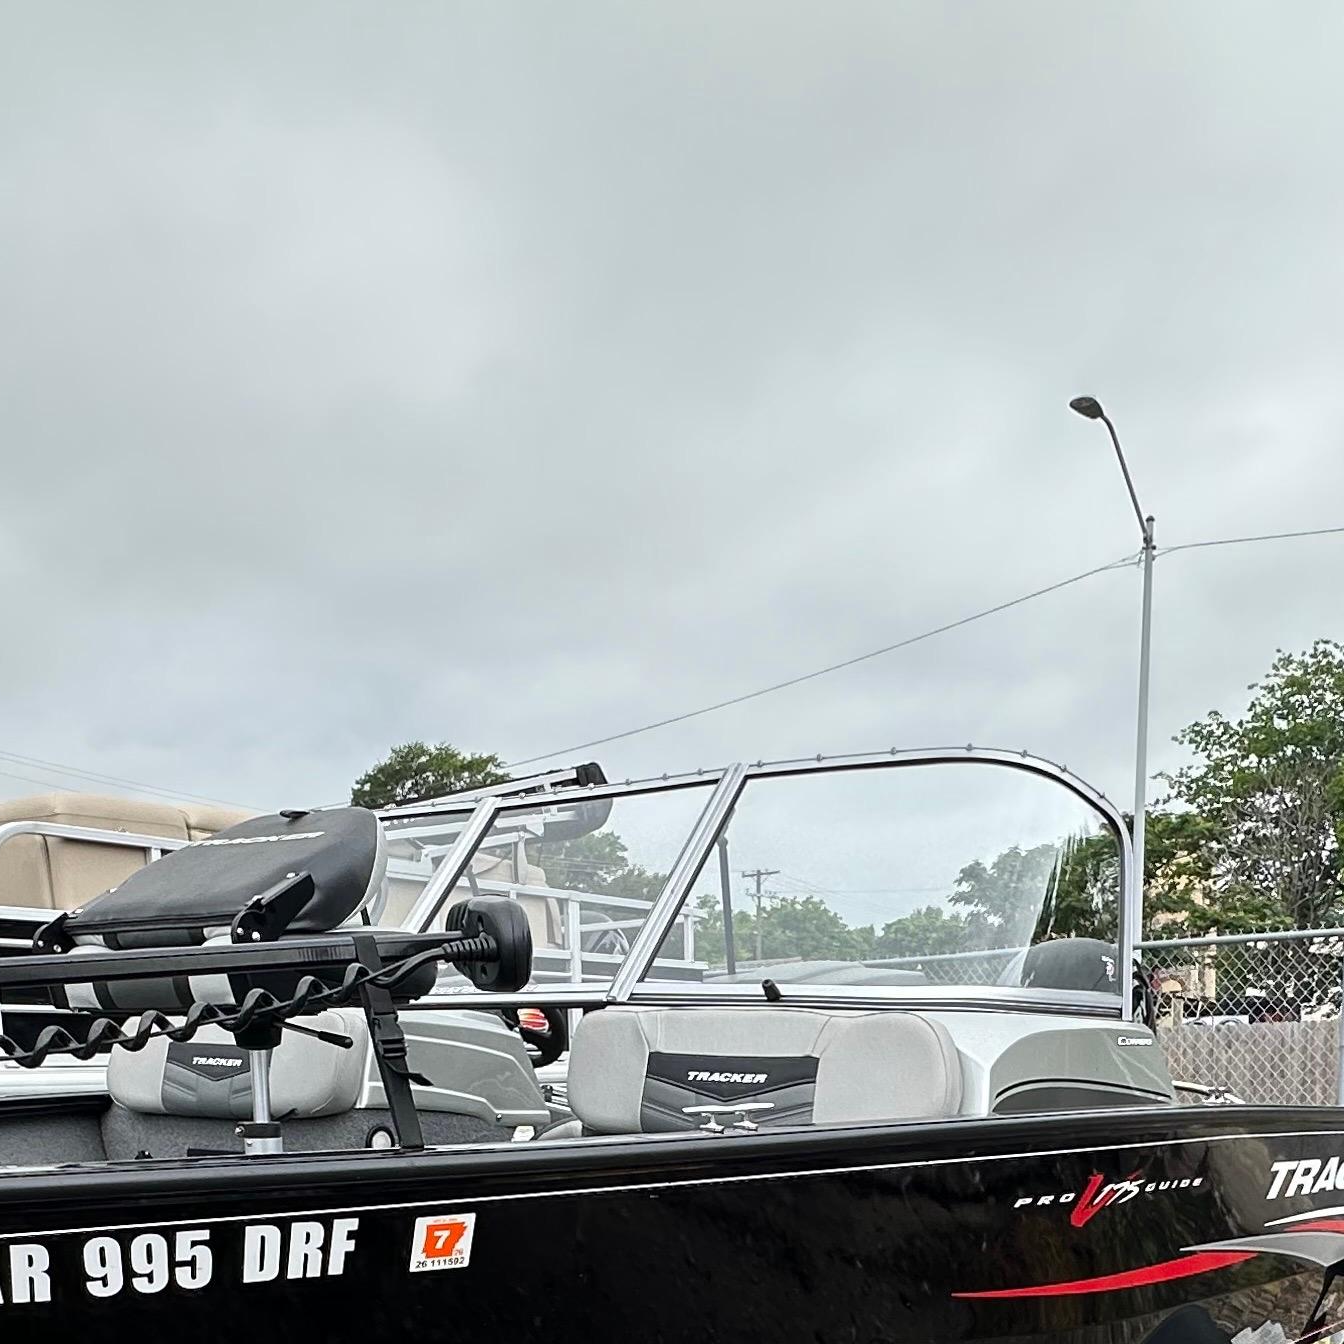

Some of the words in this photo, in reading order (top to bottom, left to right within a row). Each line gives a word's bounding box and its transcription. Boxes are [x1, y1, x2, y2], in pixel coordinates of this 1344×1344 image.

[192, 1056, 244, 1068] TRACKER
[687, 1071, 769, 1084] TRACKER
[1013, 1192, 1077, 1209] PRO
[1144, 1177, 1204, 1193] GUIDE
[433, 1229, 452, 1250] 7
[83, 1229, 213, 1298] 995
[242, 1217, 360, 1284] DRF
